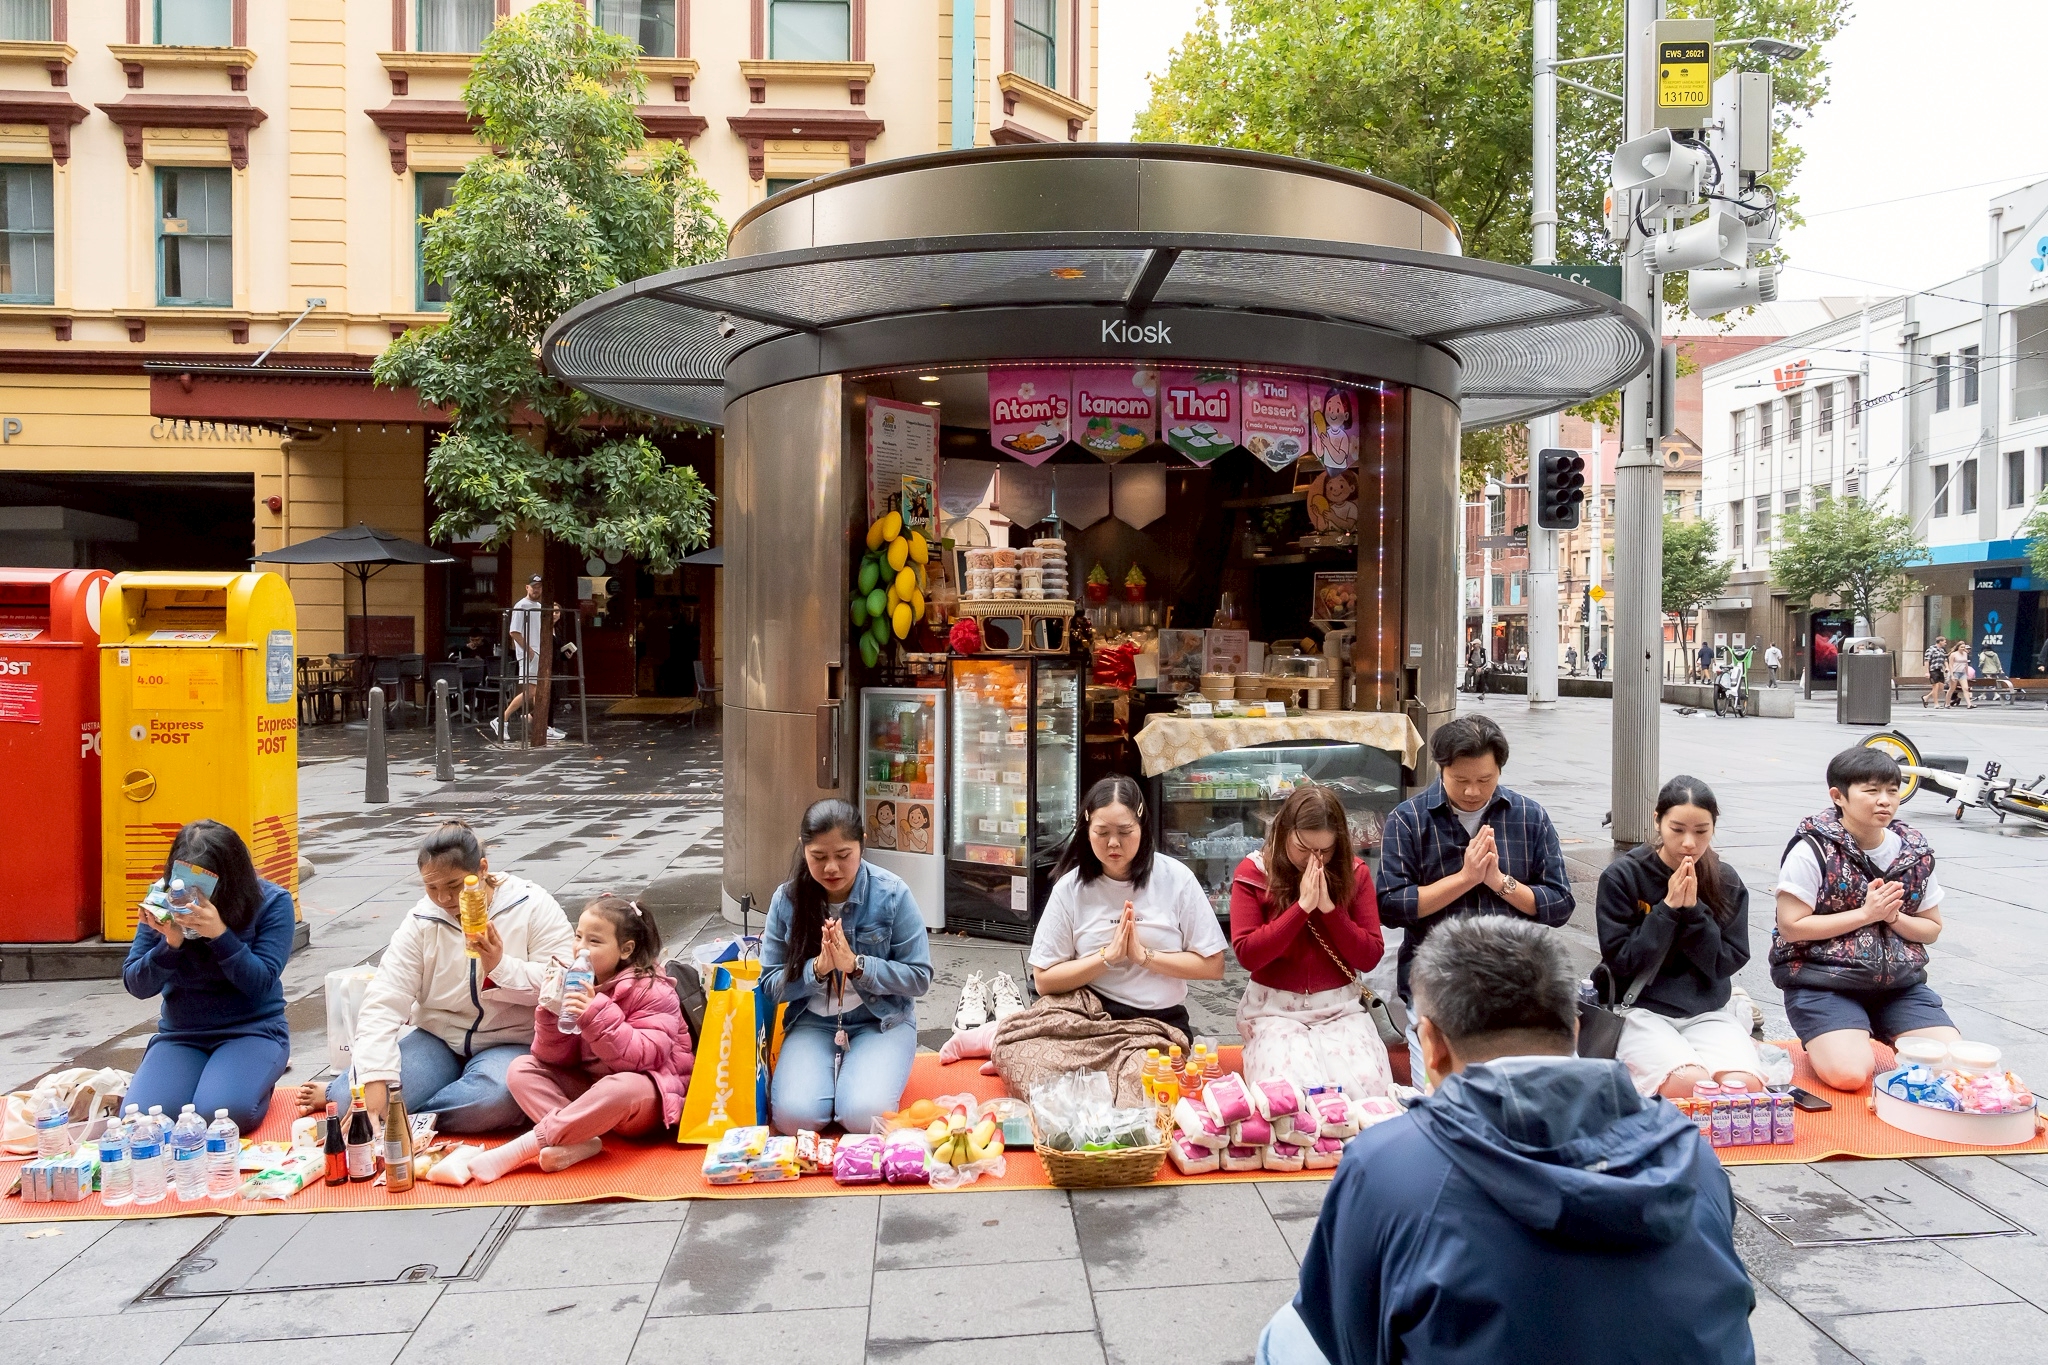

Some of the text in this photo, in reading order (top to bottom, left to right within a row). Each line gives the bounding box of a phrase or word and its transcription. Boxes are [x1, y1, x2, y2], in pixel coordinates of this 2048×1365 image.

[1666, 50, 1704, 58] EWS_26021
[1664, 91, 1704, 102] 131700
[1101, 319, 1172, 344] Kiosk
[1262, 381, 1289, 399] Thai
[994, 396, 1068, 422] Atom's
[1080, 391, 1149, 417] kanom
[1169, 389, 1228, 419] Thai
[1252, 400, 1297, 419] Dessert
[3, 417, 23, 443] P
[150, 422, 253, 442] CARPARK
[1264, 421, 1280, 432] fresh
[1280, 422, 1305, 435] everyday)
[1976, 581, 1994, 589] ANZ
[1981, 634, 2004, 646] ANZ
[0, 661, 32, 675] OST
[136, 674, 164, 685] 4.00
[150, 718, 204, 733] Express
[257, 715, 297, 736] Express
[150, 732, 190, 744] POST
[257, 735, 287, 756] POST
